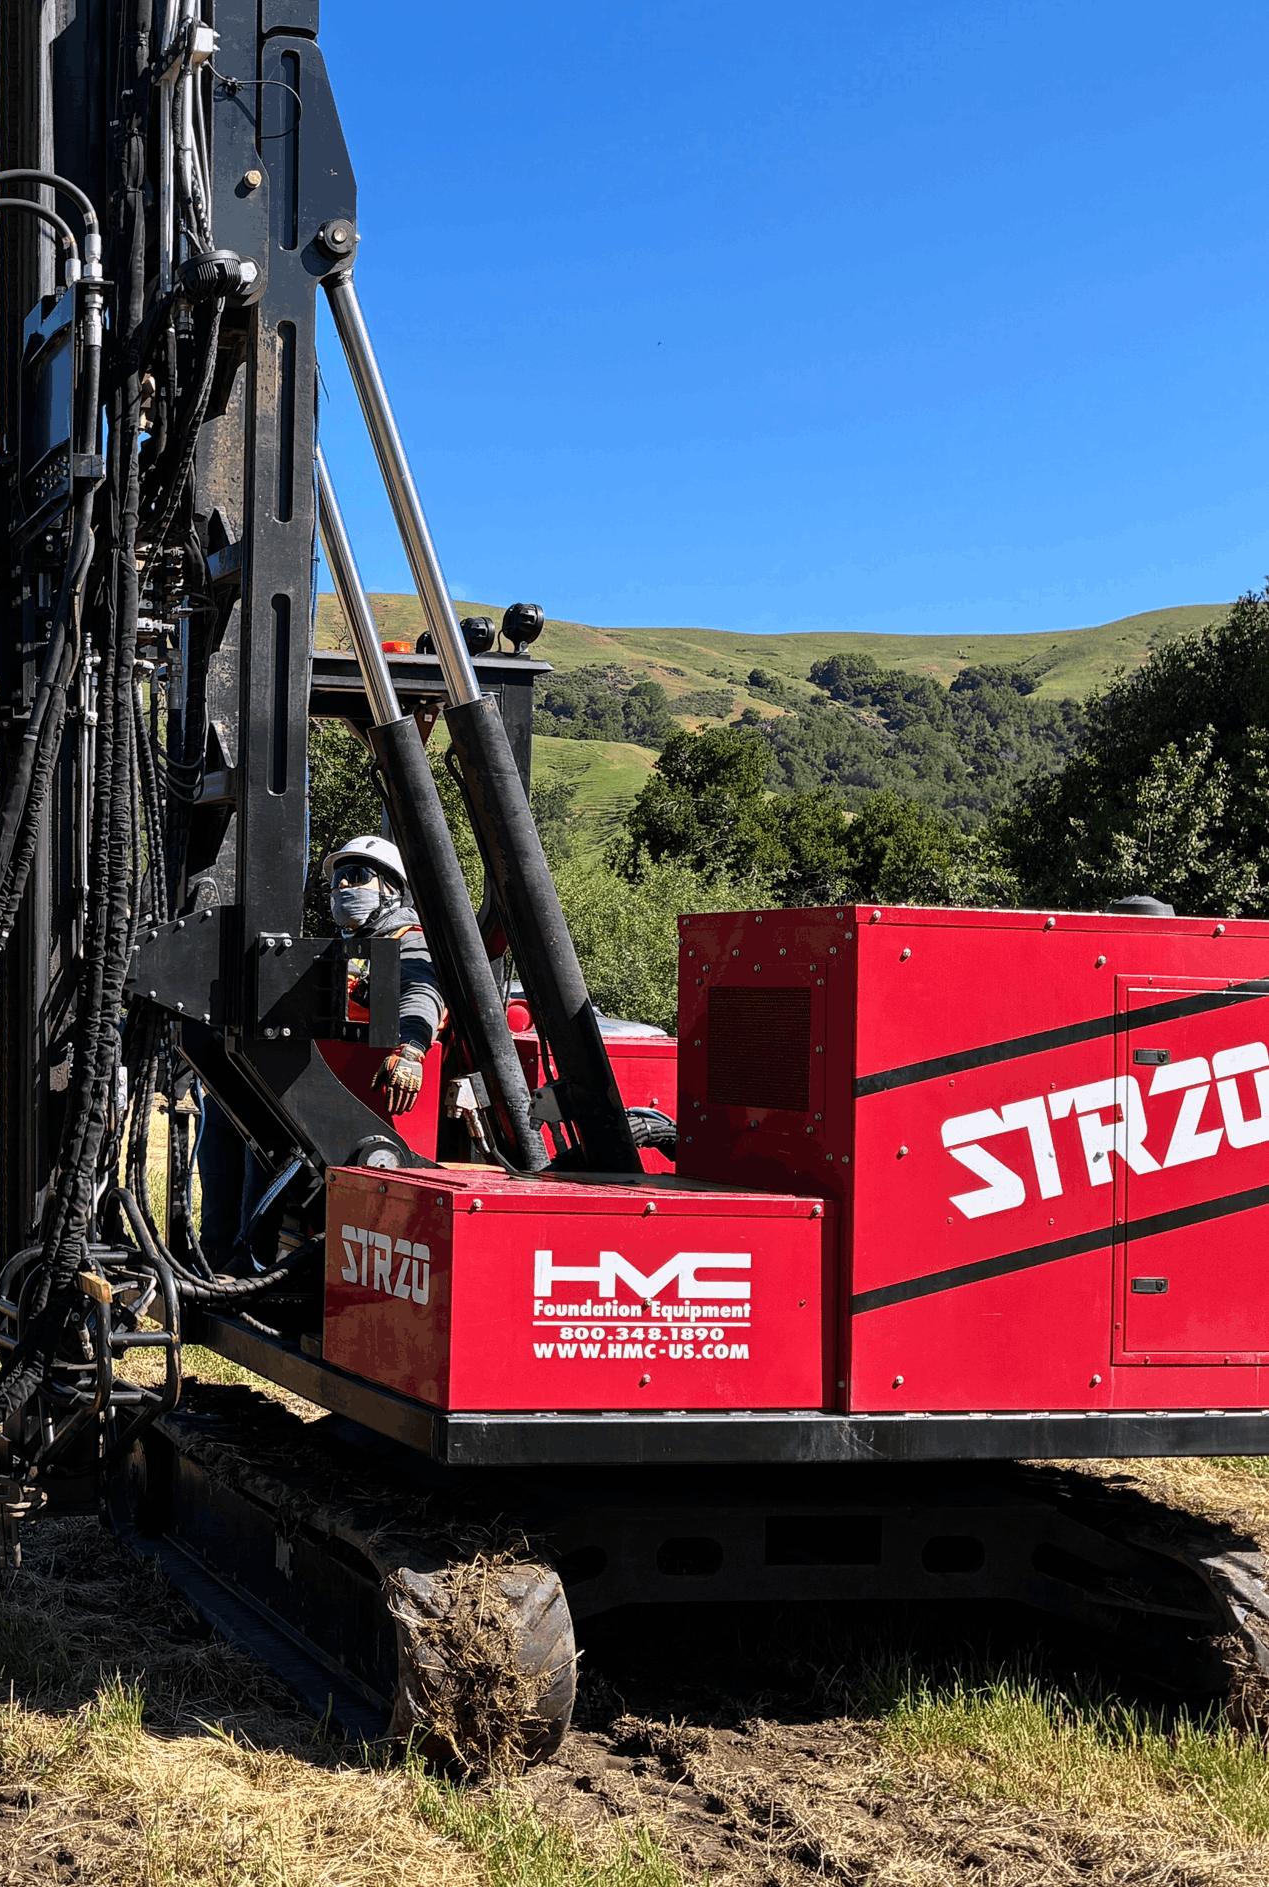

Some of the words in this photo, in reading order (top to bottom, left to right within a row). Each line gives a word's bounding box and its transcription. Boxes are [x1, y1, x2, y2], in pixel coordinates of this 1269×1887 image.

[534, 1250, 751, 1298] HMC
[533, 1299, 642, 1317] Foundation
[650, 1300, 751, 1322] Equipment
[559, 1327, 724, 1341] 800.348.1890
[533, 1343, 750, 1359] WWW.HMC-US.COM
